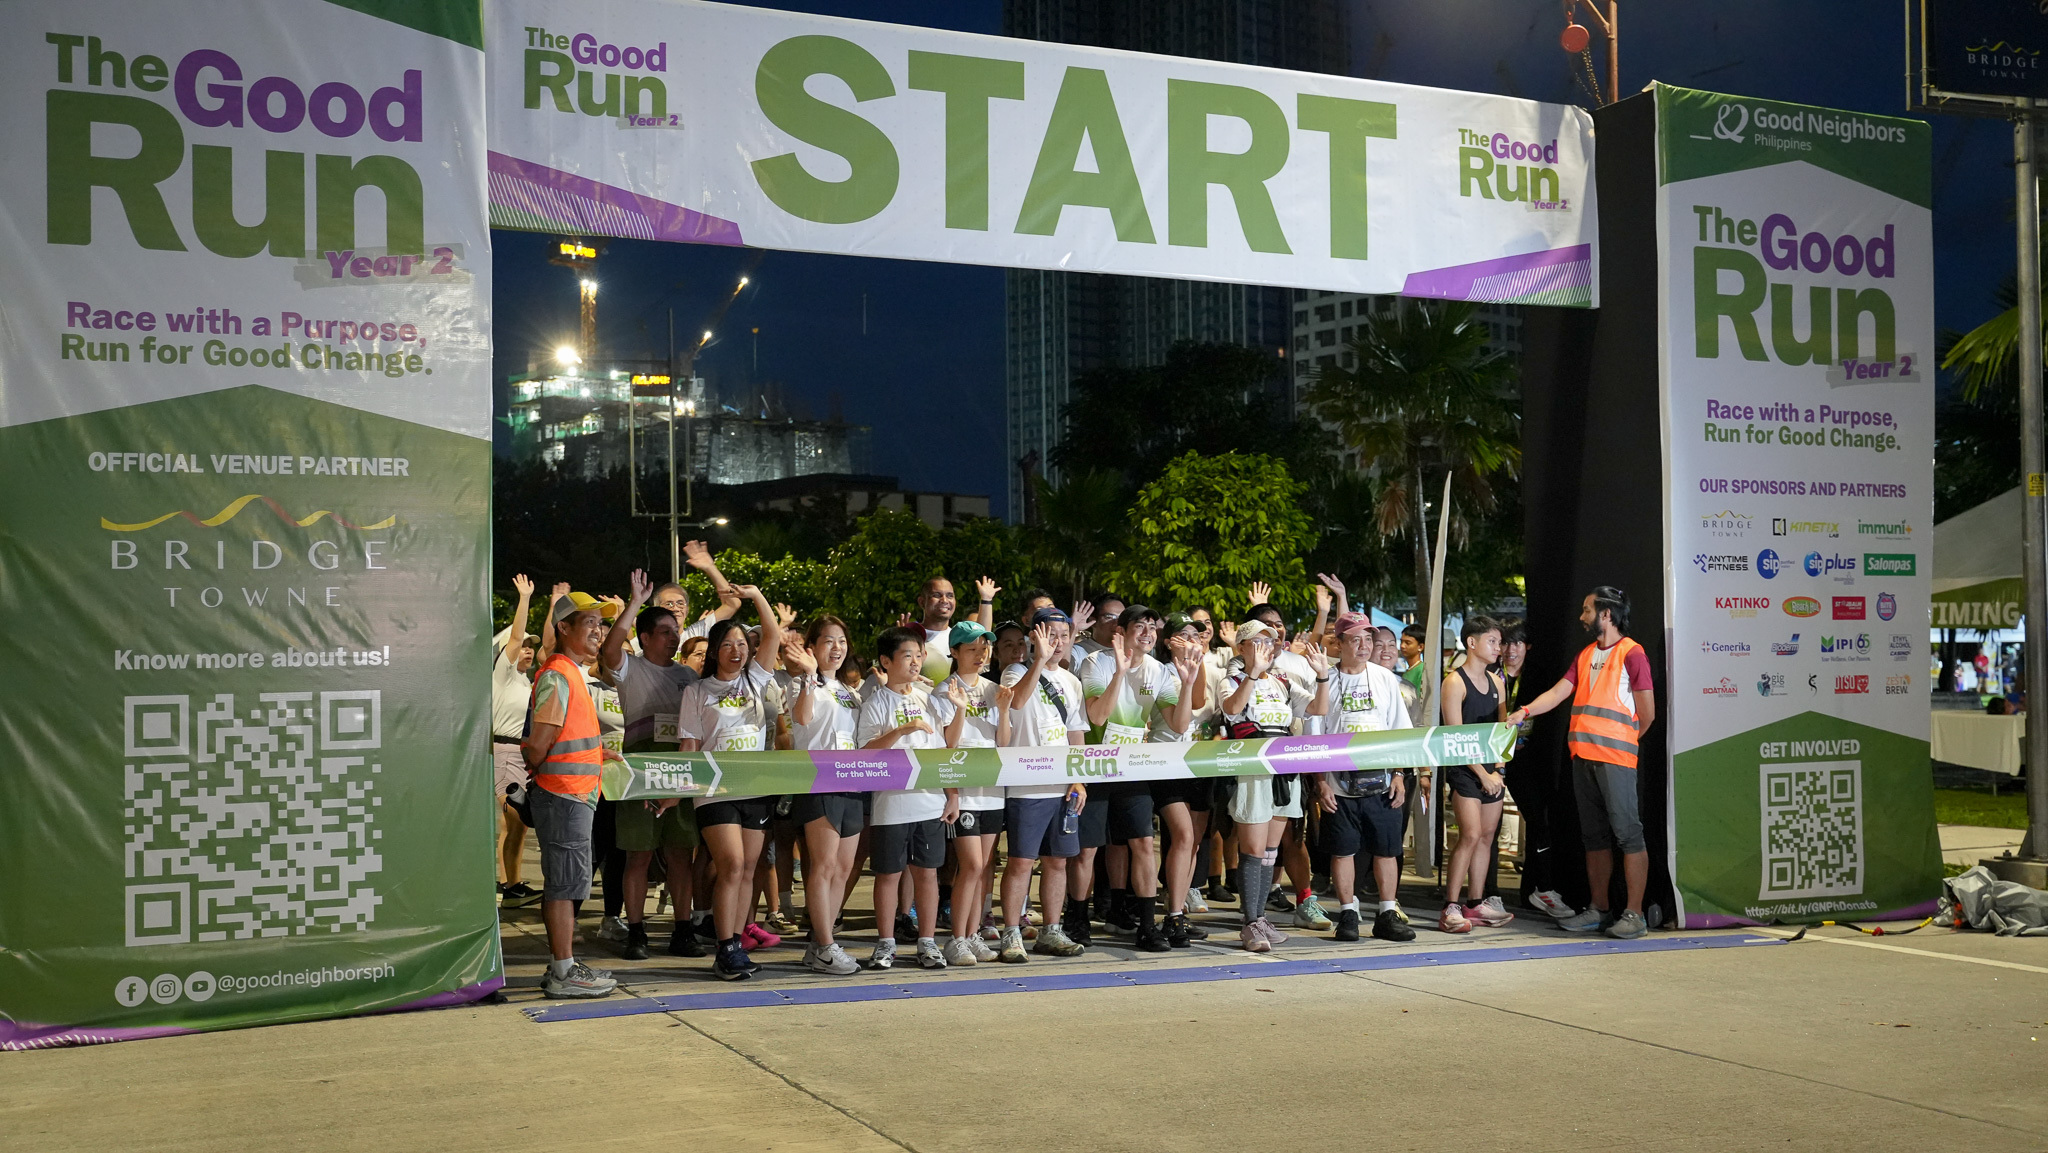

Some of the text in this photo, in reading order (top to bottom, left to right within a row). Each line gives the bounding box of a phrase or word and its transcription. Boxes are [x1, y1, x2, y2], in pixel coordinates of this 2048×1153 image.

[525, 26, 667, 73] The Good
[1968, 53, 2038, 68] BRIDGE
[46, 32, 423, 142] The Good
[524, 48, 667, 119] Run
[628, 114, 679, 127] Year 2
[1754, 107, 1906, 144] Good Neighbors
[750, 34, 1397, 261] START
[1458, 128, 1558, 165] The Good
[1755, 133, 1812, 151] Philippines
[46, 89, 424, 265] Run
[1459, 146, 1559, 203] Run
[1533, 199, 1567, 210] Year 2
[1693, 205, 1895, 279] The Good
[325, 247, 454, 280] Year 2
[1693, 246, 1896, 368] Run
[66, 301, 427, 348] Race with a Purpose,
[61, 334, 432, 378] Run for Good Change.
[1842, 356, 1912, 380] Year 2
[1707, 399, 1898, 430] Race with a Purpose,
[1704, 423, 1901, 453] Run for Good Change.
[88, 451, 410, 477] OFFICIAL VENUE PARTNER
[1700, 478, 1906, 499] OUR SPONSORS AND PARTNERS
[1703, 520, 1752, 529] BRIDGE
[111, 540, 387, 570] BRIDGE
[1708, 555, 1748, 563] ANYTIME
[1762, 551, 1779, 574] sip
[1809, 553, 1823, 572] sip
[1825, 553, 1856, 575] plus
[1868, 558, 1911, 571] Salonpas
[164, 586, 341, 608] TOWNE
[1716, 597, 1770, 608] KATINKO
[1712, 642, 1750, 652] Generika
[1836, 639, 1852, 650] IPI
[115, 645, 390, 670] Know more about us!
[1771, 673, 1785, 685] gig
[1352, 690, 1372, 699] Good
[604, 702, 624, 714] Ru
[1260, 711, 1288, 723] 2037
[726, 736, 757, 751] 2010
[1454, 732, 1479, 742] Good
[1084, 746, 1120, 757] Good
[1303, 744, 1329, 752] Change
[1444, 740, 1481, 758] Run
[1760, 739, 1860, 758] GET INVOLVED
[644, 761, 692, 772] The Good
[835, 761, 888, 770] Good Change
[1026, 764, 1054, 772] Purpose,
[1066, 754, 1118, 777] Run
[1145, 759, 1168, 768] Change.
[645, 769, 694, 790] Run
[836, 769, 891, 778] for the World.
[939, 772, 967, 780] Neighbors
[1745, 900, 1877, 918] https://bit.ly/GNPhDonate
[218, 962, 395, 994] @goodneighborsph
